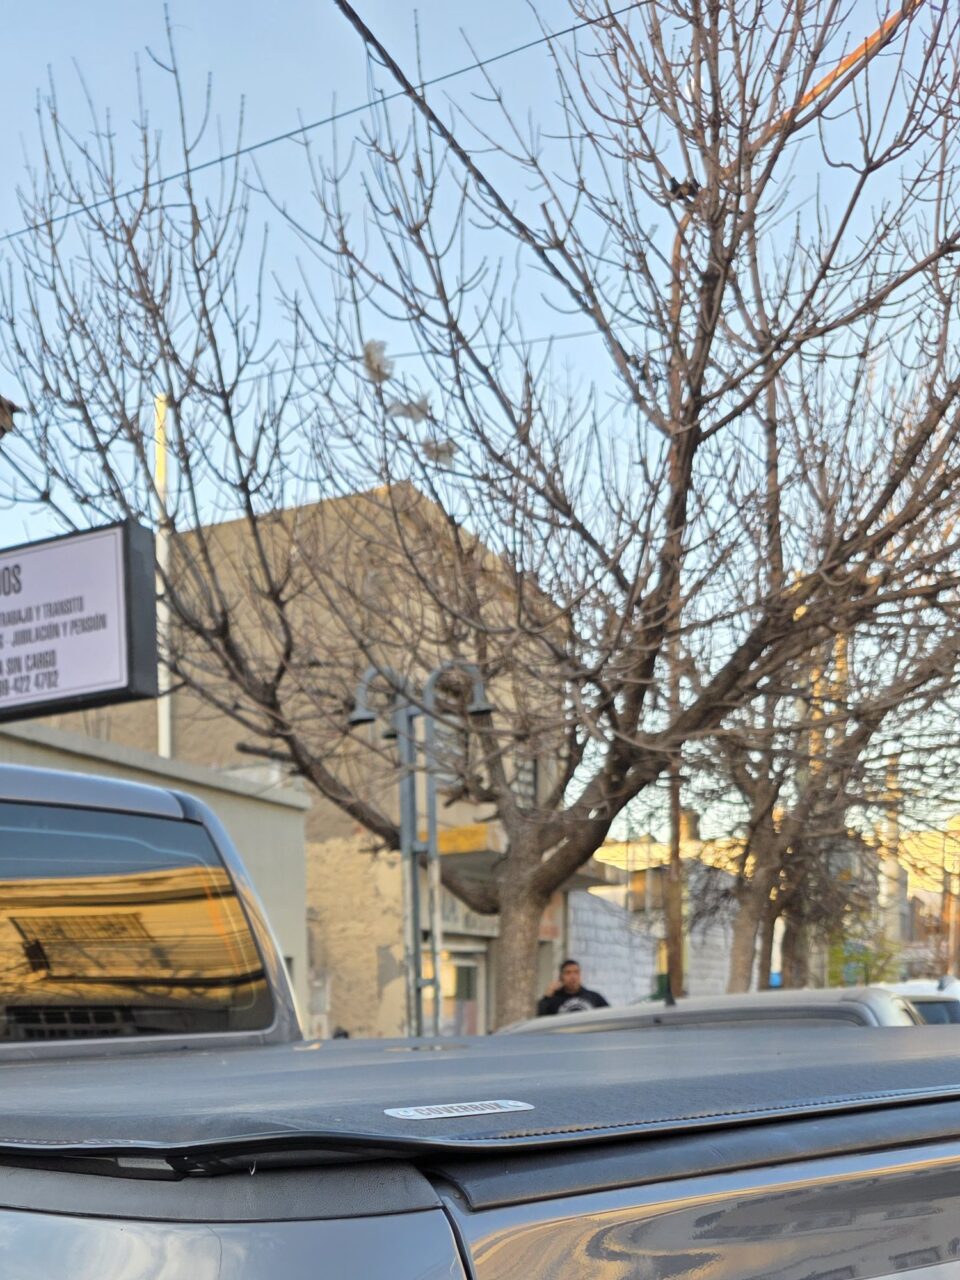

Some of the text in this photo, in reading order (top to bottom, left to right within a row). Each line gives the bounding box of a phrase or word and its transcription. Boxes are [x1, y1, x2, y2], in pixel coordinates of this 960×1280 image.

[34, 604, 41, 621] Y
[61, 621, 68, 637] Y
[5, 656, 22, 676] SIN
[24, 649, 57, 672] CARGO
[413, 1102, 504, 1116] COVERBOX
